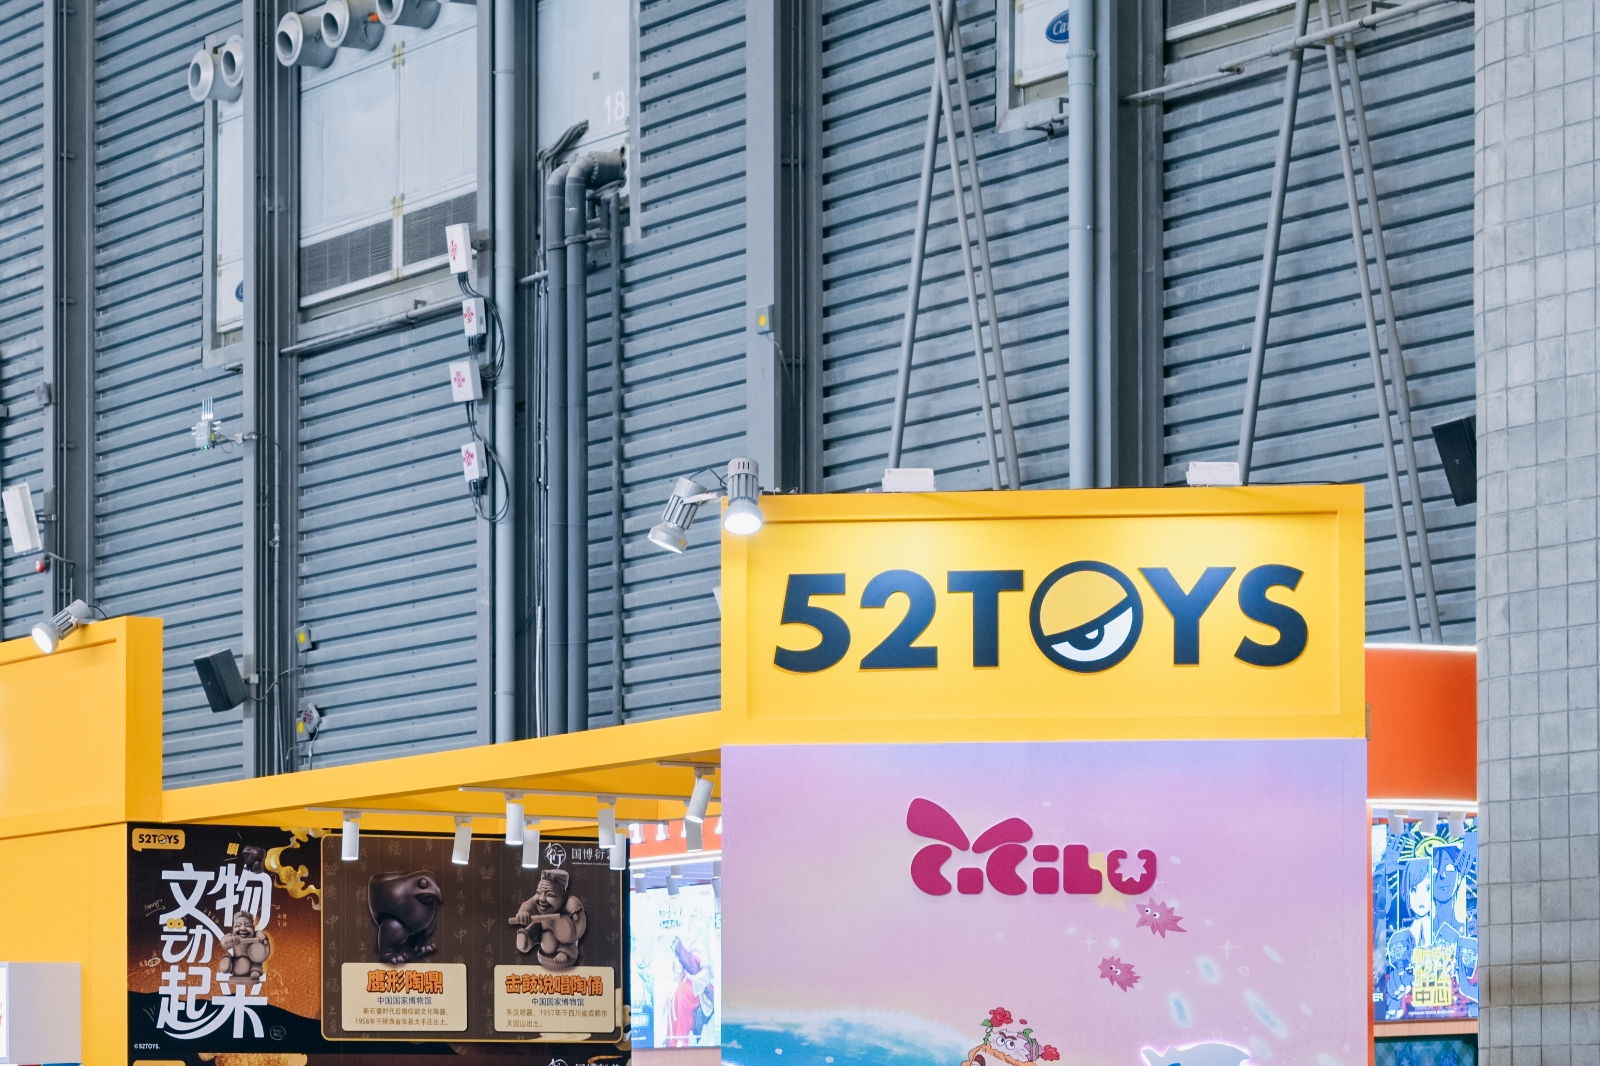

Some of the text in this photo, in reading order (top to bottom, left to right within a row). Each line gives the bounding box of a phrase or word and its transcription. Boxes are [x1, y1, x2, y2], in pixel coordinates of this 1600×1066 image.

[604, 90, 625, 125] 18
[773, 559, 1309, 673] 52TOYS
[138, 834, 179, 845] 52TOYS
[159, 862, 272, 932] 文物
[366, 969, 444, 994] 鹰形陶鼎
[505, 973, 604, 996] 击鼓说唱陶俑
[377, 996, 432, 1005] 中国国家博物馆
[532, 998, 584, 1006] 中国国家博物馆
[1415, 988, 1449, 1004] 中心
